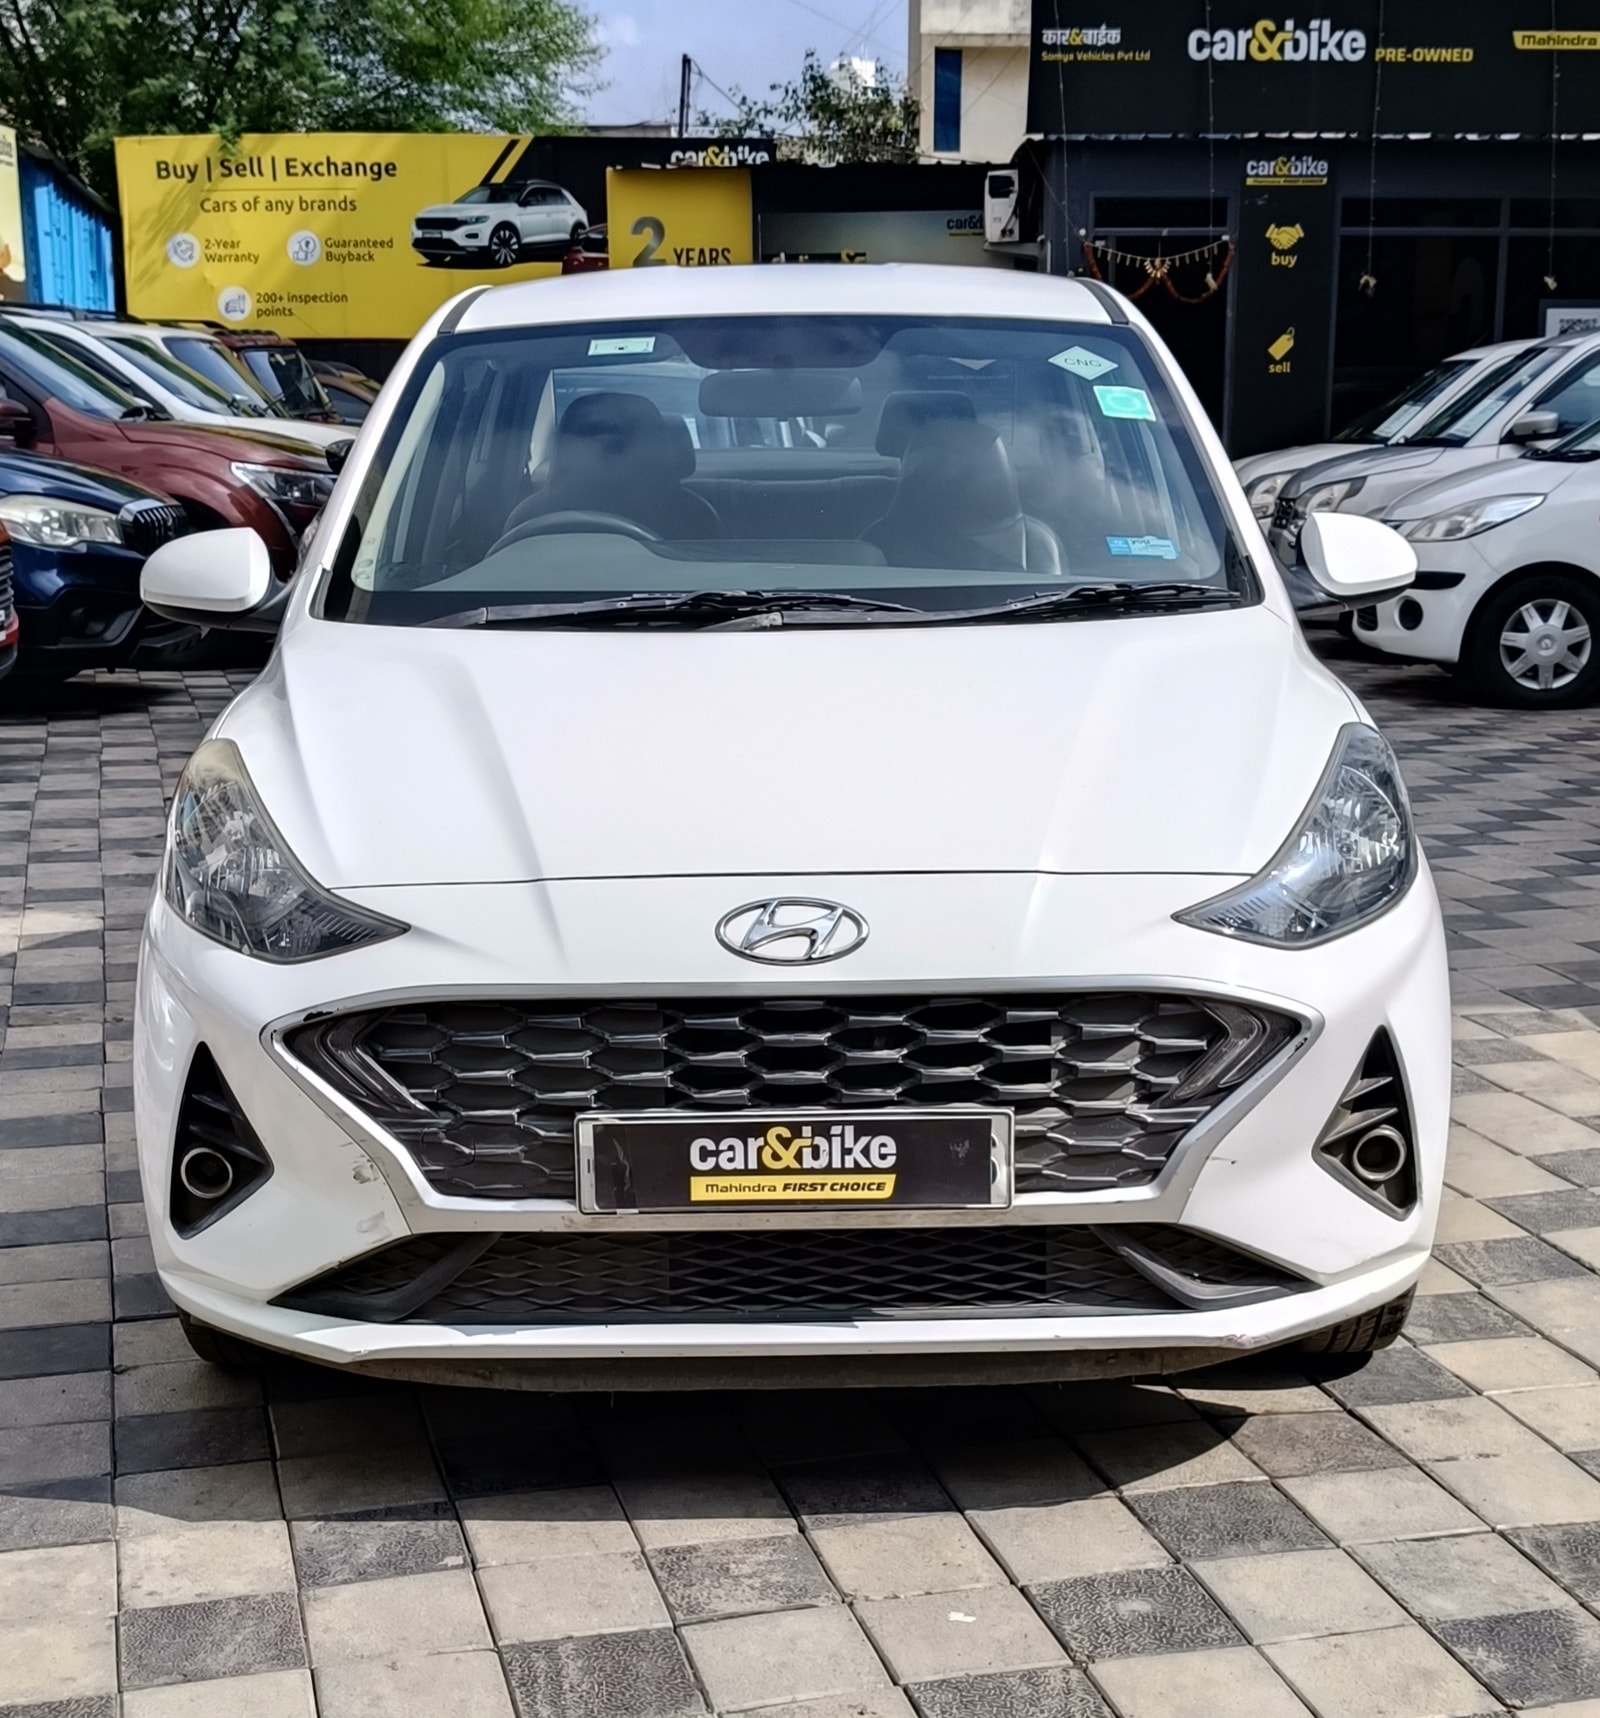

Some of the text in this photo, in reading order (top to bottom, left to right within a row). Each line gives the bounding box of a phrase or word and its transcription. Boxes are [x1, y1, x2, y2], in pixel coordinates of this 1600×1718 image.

[1041, 22, 1121, 47] कार&बाईक
[1187, 18, 1474, 62] car&bike PRE-OWNED
[1521, 34, 1598, 46] Mahindra
[1076, 49, 1115, 61] Vehicles
[1117, 49, 1134, 61] Pvt
[1135, 48, 1151, 61] Ltd
[156, 160, 199, 184] Buy
[219, 156, 265, 179] Sell
[285, 155, 398, 182] Exchange
[1246, 155, 1329, 176] car&bike
[200, 195, 358, 215] Cars of any brands
[204, 238, 241, 250] 2-Year
[324, 237, 394, 249] Guaranteed
[630, 216, 667, 268] 2
[204, 252, 260, 265] Warranty
[325, 251, 375, 263] Buyback
[1271, 251, 1298, 268] buy
[255, 291, 348, 305] 200+ inspection
[256, 306, 294, 319] points
[1063, 357, 1102, 368] CNG
[1268, 361, 1291, 373] sell
[689, 1124, 898, 1171] car&bike
[705, 1181, 887, 1194] Mahindra FIRST CHOICE
